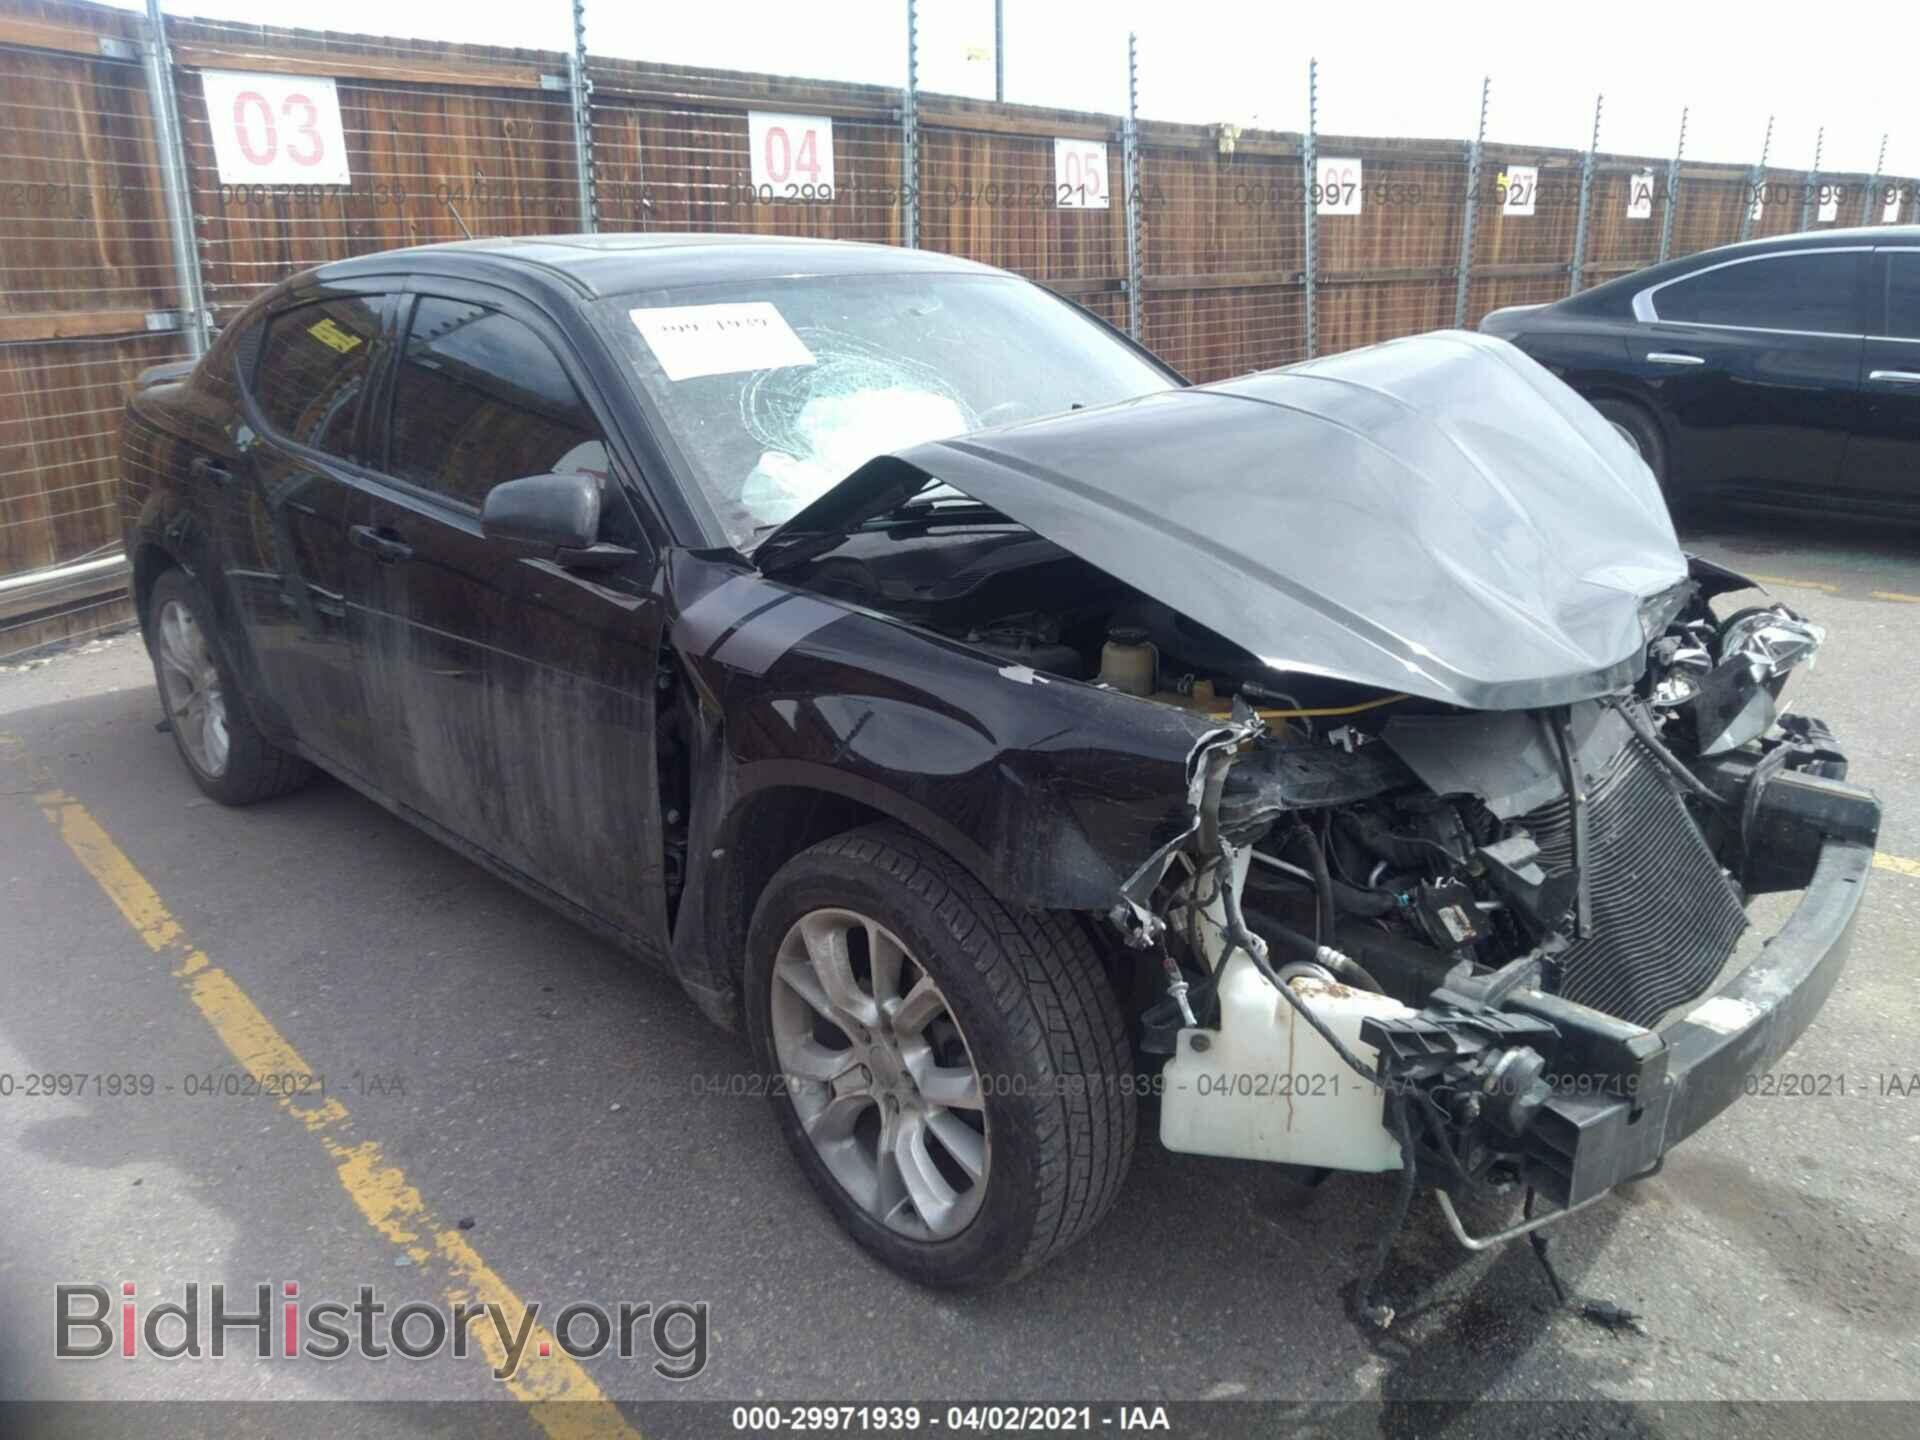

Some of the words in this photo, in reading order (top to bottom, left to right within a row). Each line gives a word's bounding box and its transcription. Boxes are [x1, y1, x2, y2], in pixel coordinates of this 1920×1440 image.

[233, 91, 324, 166] 03
[764, 126, 822, 184] 04
[1065, 151, 1102, 197] 05
